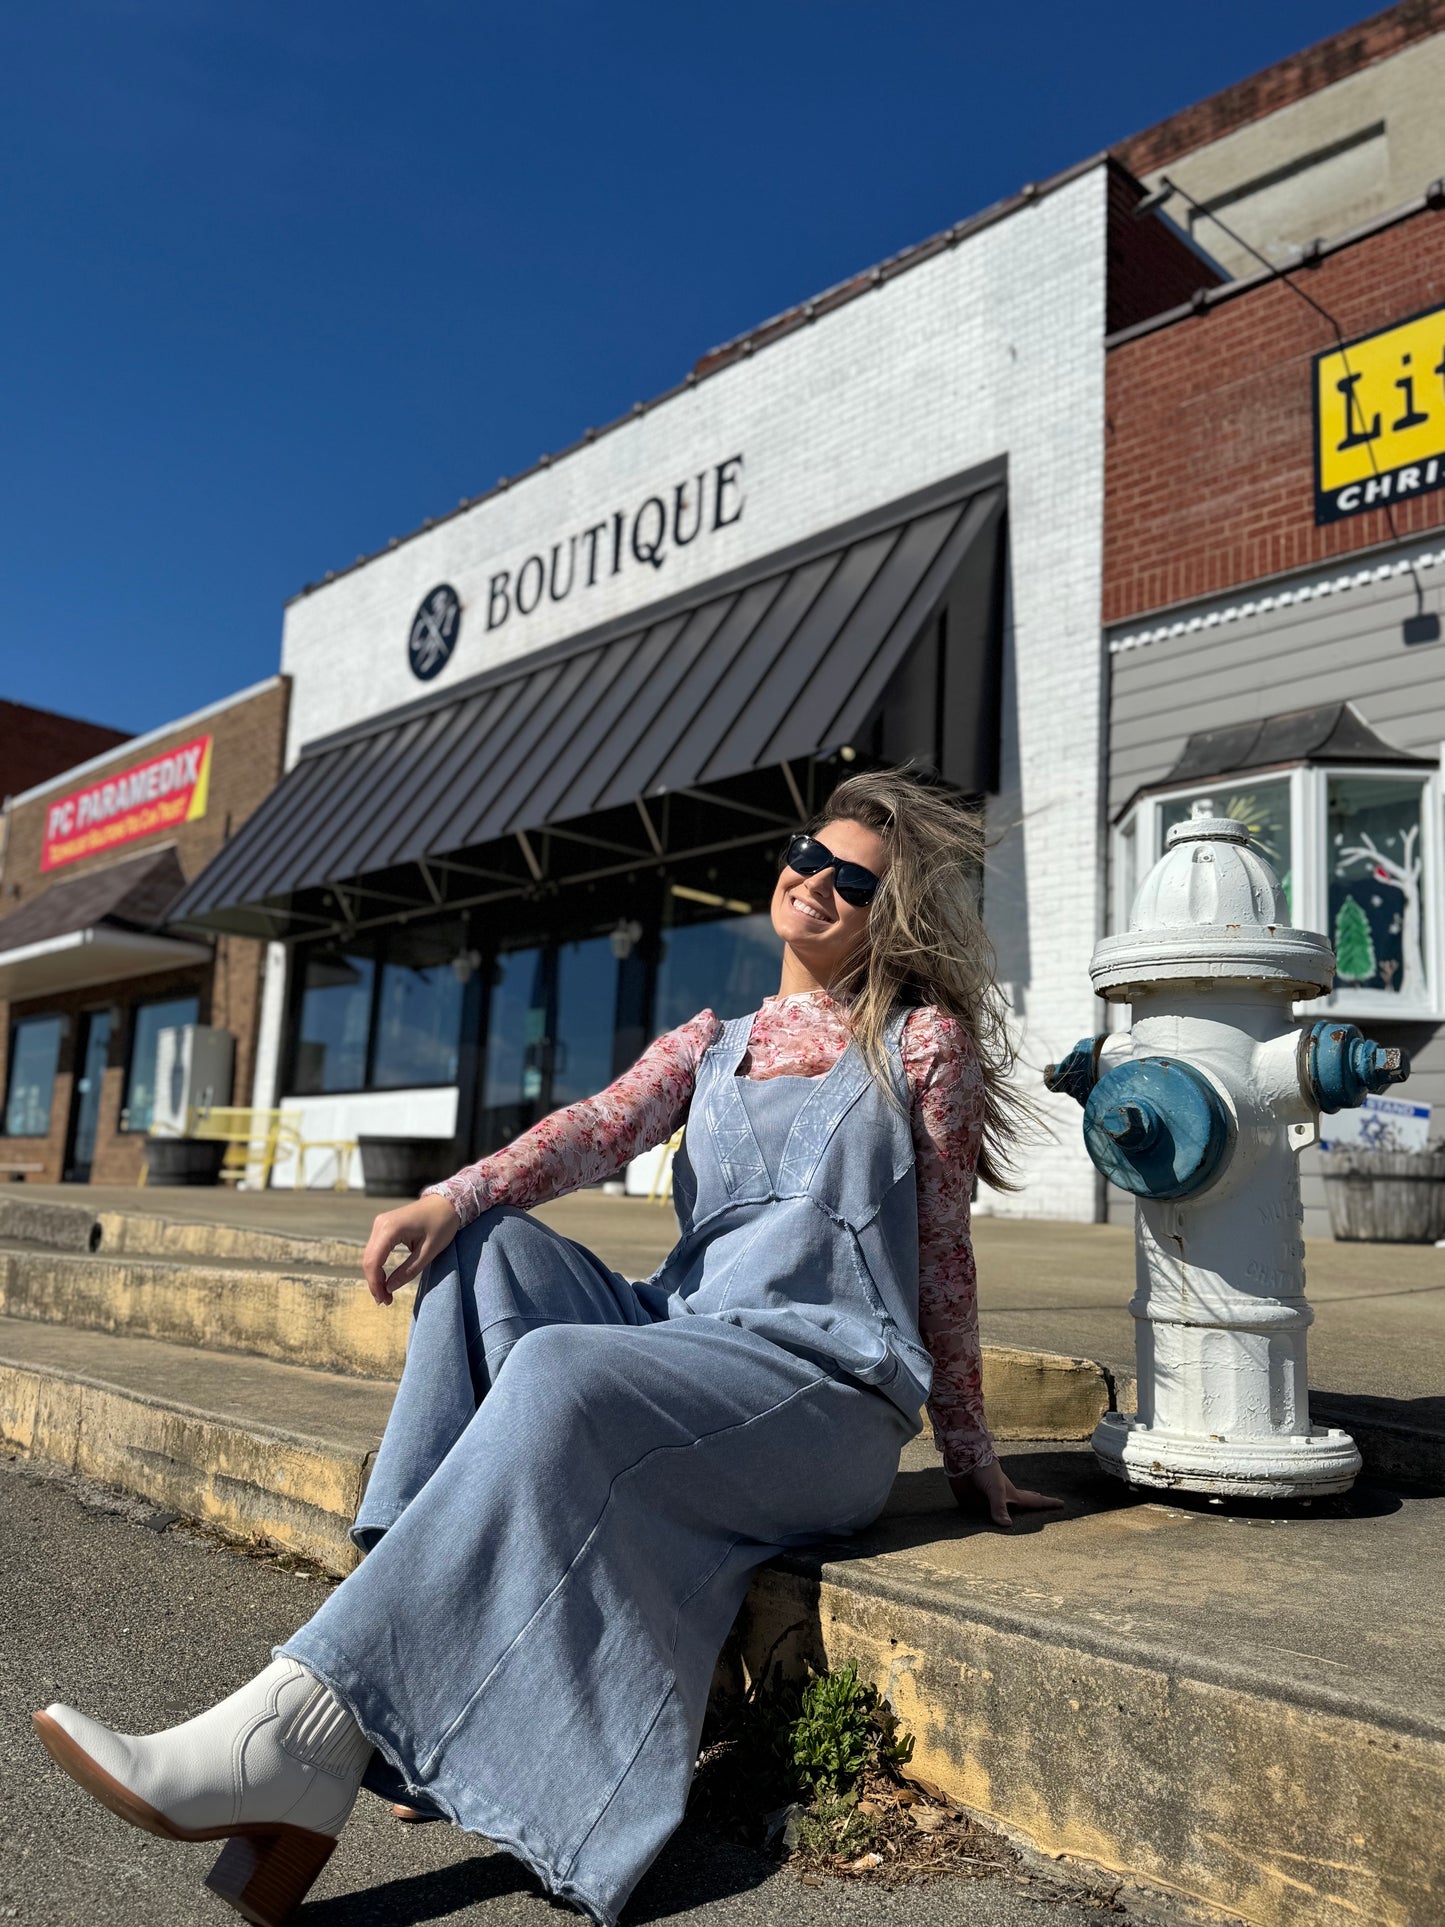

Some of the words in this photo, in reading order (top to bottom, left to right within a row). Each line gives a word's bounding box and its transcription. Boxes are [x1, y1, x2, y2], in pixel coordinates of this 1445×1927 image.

[1336, 459, 1445, 511] CHRI
[486, 455, 746, 631] BOUTIQUE
[48, 801, 75, 841] PC
[77, 745, 200, 828] PARAMEDIX
[1366, 1099, 1415, 1116] STAND
